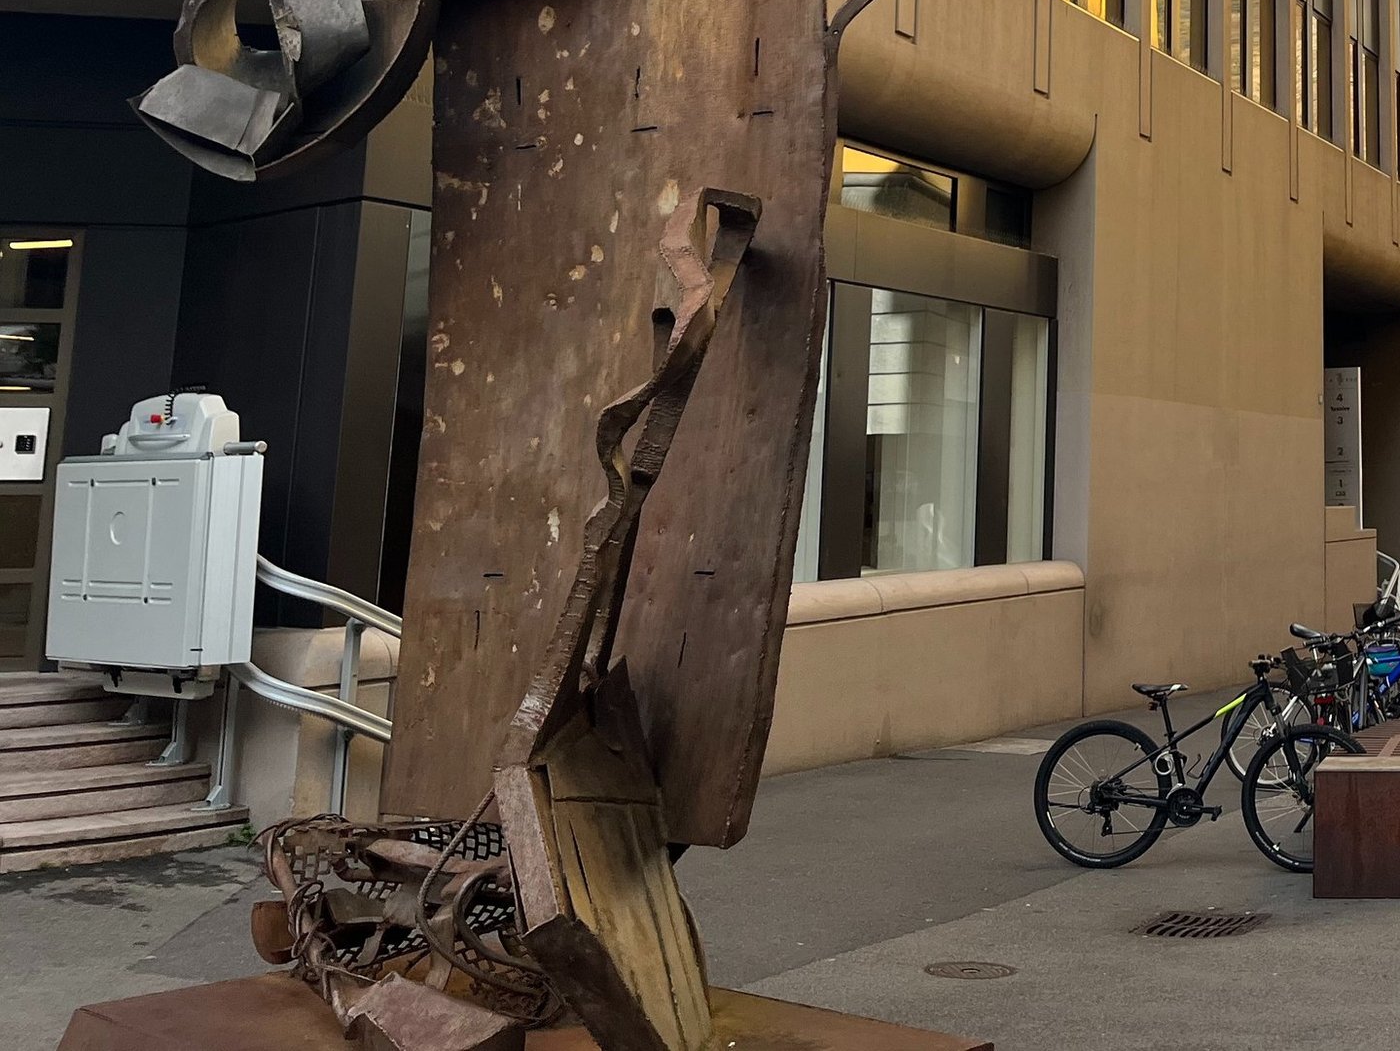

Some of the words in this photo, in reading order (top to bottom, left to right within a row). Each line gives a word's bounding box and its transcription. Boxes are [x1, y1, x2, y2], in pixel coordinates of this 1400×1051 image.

[1336, 393, 1344, 402] 4
[1336, 415, 1344, 425] 3
[1336, 446, 1344, 456] 2
